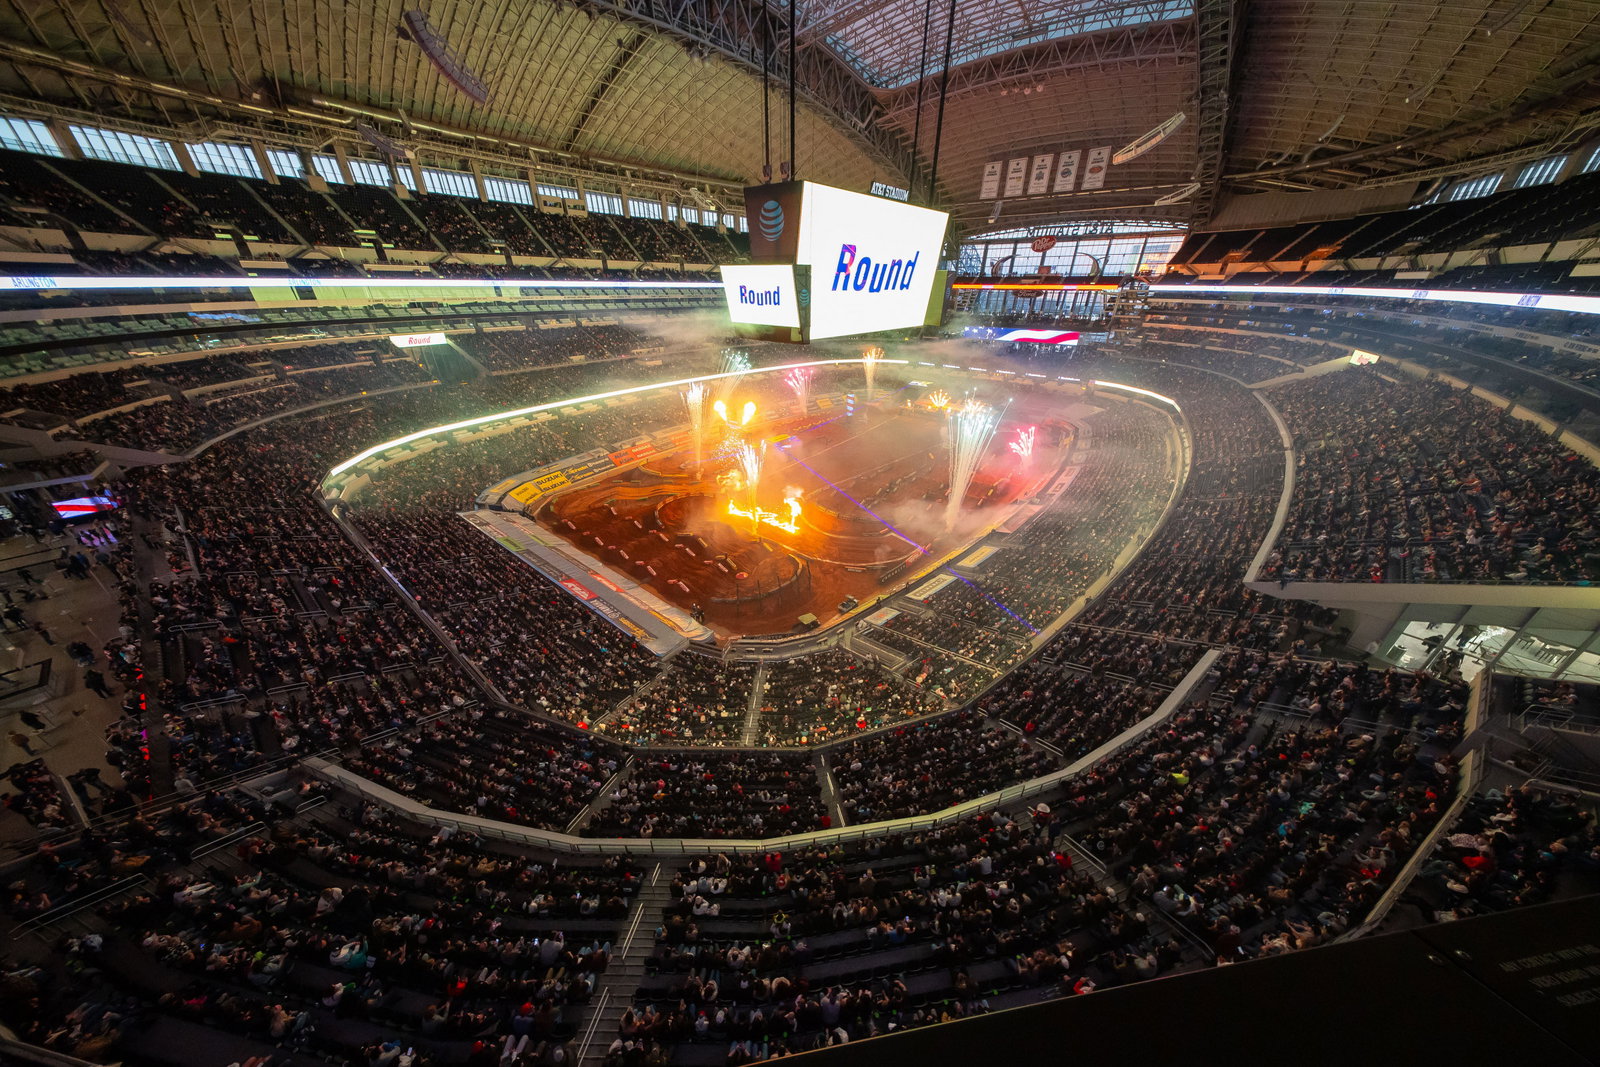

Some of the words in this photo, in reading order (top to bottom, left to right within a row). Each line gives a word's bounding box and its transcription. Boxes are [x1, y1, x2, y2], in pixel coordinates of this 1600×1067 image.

[870, 181, 886, 197] AT&T
[885, 185, 909, 202] STADIUM
[832, 243, 920, 293] Round
[11, 276, 57, 288] ARLINGTON
[739, 285, 780, 306] Round
[408, 335, 431, 345] Round
[536, 473, 563, 486] SUZUKI
